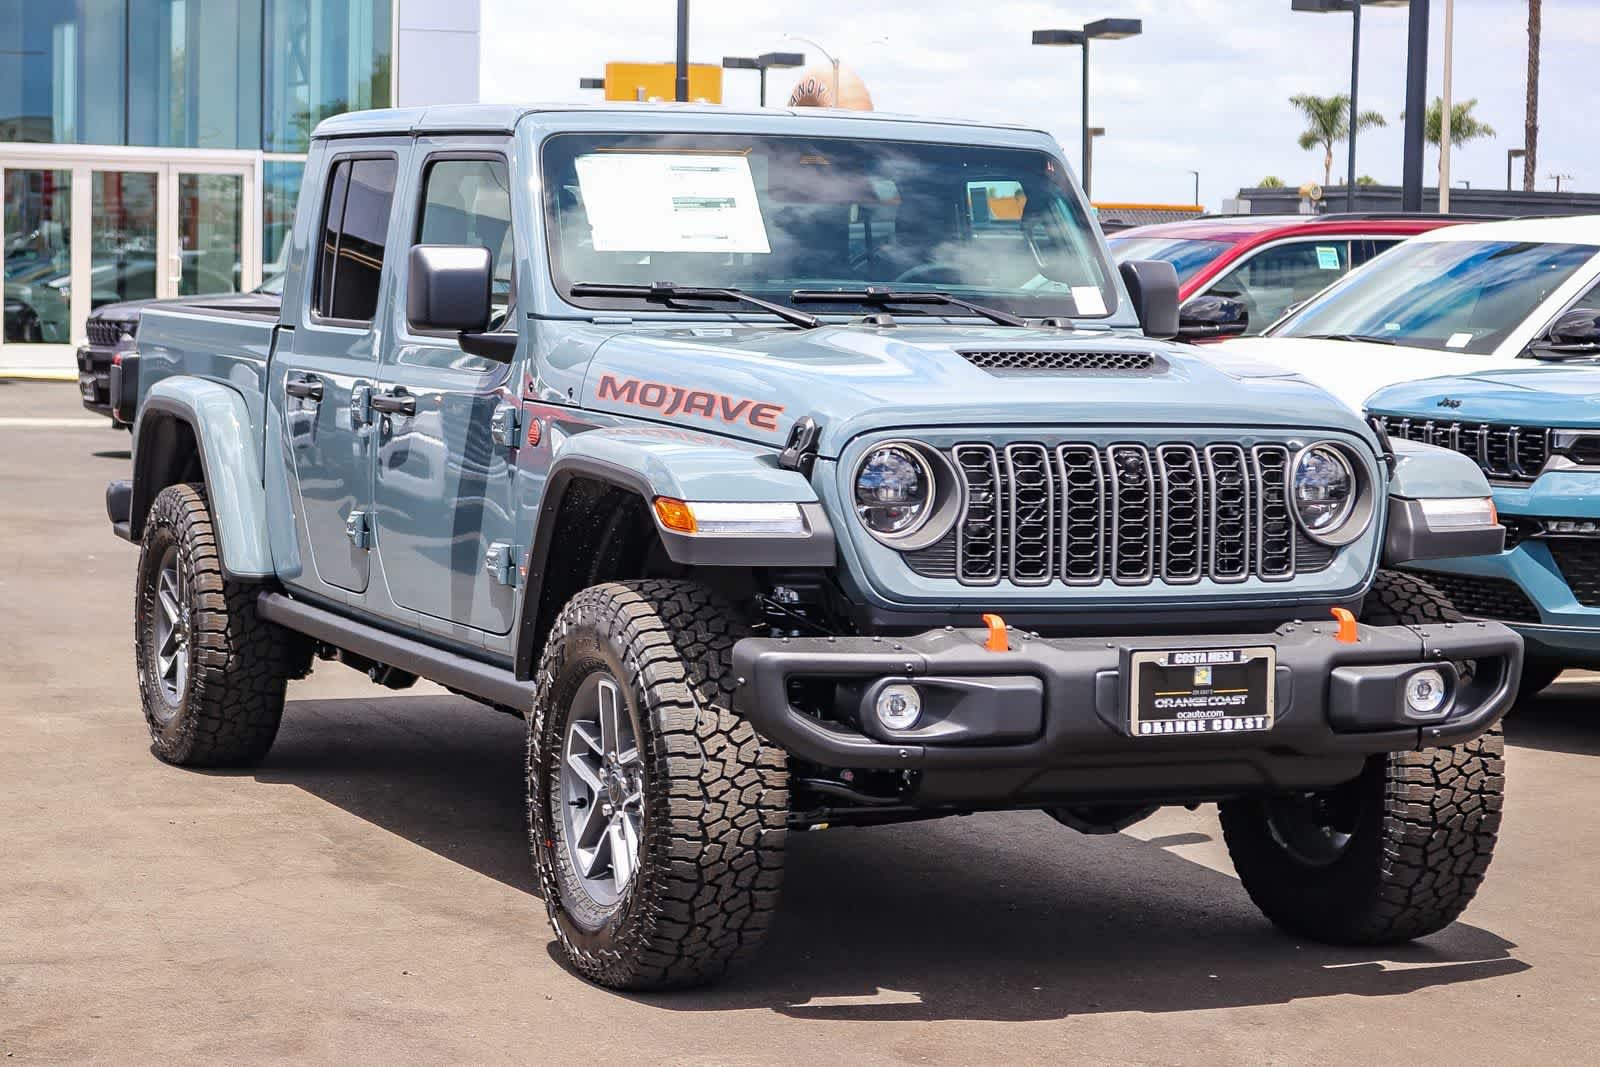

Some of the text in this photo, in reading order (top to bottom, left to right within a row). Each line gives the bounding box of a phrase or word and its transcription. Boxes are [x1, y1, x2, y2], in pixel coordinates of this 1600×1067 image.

[597, 374, 786, 432] MOJAVE
[1174, 651, 1235, 664] COSTA MESA
[1154, 695, 1249, 708] ORANGE COAST
[1176, 710, 1225, 719] ocauto.com
[1140, 717, 1266, 734] ORANGE COAST
